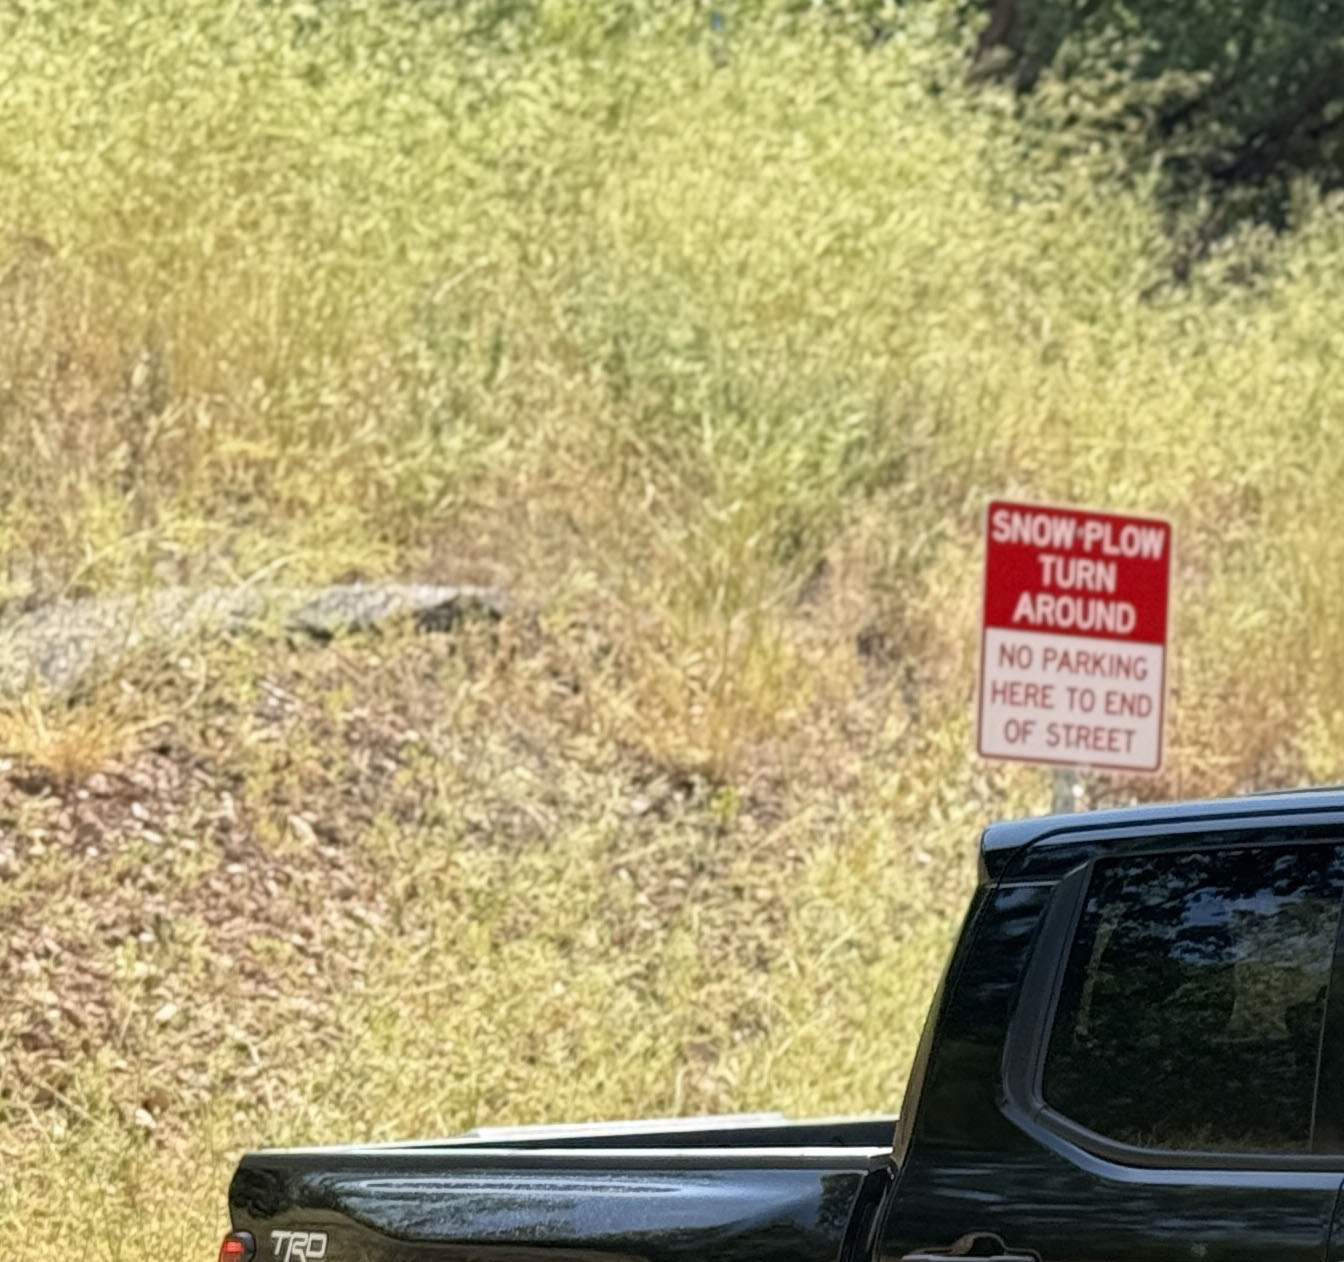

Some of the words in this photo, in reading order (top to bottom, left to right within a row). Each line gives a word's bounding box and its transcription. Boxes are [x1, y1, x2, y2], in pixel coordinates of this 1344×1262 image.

[1038, 554, 1117, 593] TURN
[1012, 592, 1137, 634] AROUND
[998, 643, 1033, 670] NO
[1042, 647, 1148, 681] PARKING
[990, 681, 1055, 709] HERE
[1066, 687, 1096, 714] TO
[1105, 690, 1152, 718] END
[1003, 719, 1036, 744] OF
[1046, 722, 1136, 754] STREET
